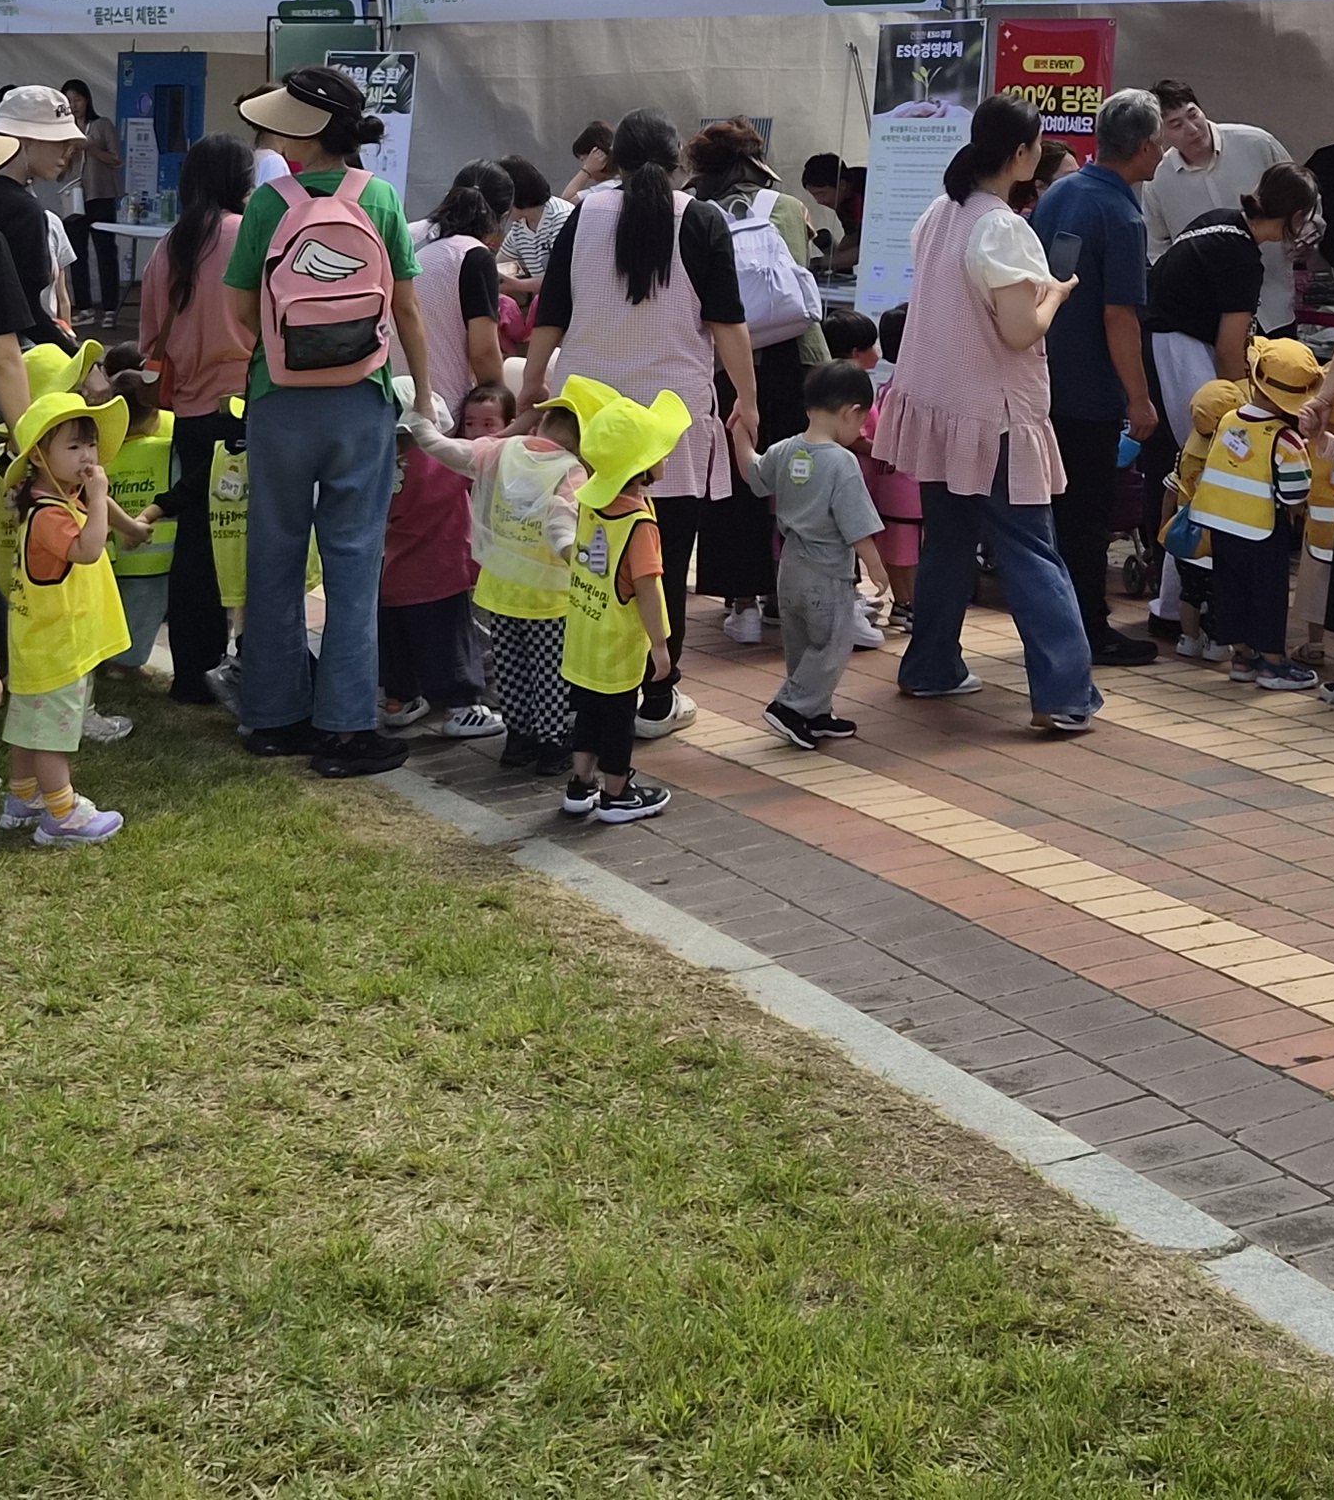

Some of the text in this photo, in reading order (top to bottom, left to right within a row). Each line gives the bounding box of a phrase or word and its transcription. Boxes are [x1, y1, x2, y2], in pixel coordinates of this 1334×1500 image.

[896, 41, 964, 59] ESG경영체계
[1049, 59, 1075, 69] EVENT
[370, 67, 400, 84] 순환
[1062, 85, 1103, 113] 당첨
[1041, 115, 1094, 133] 여하세요
